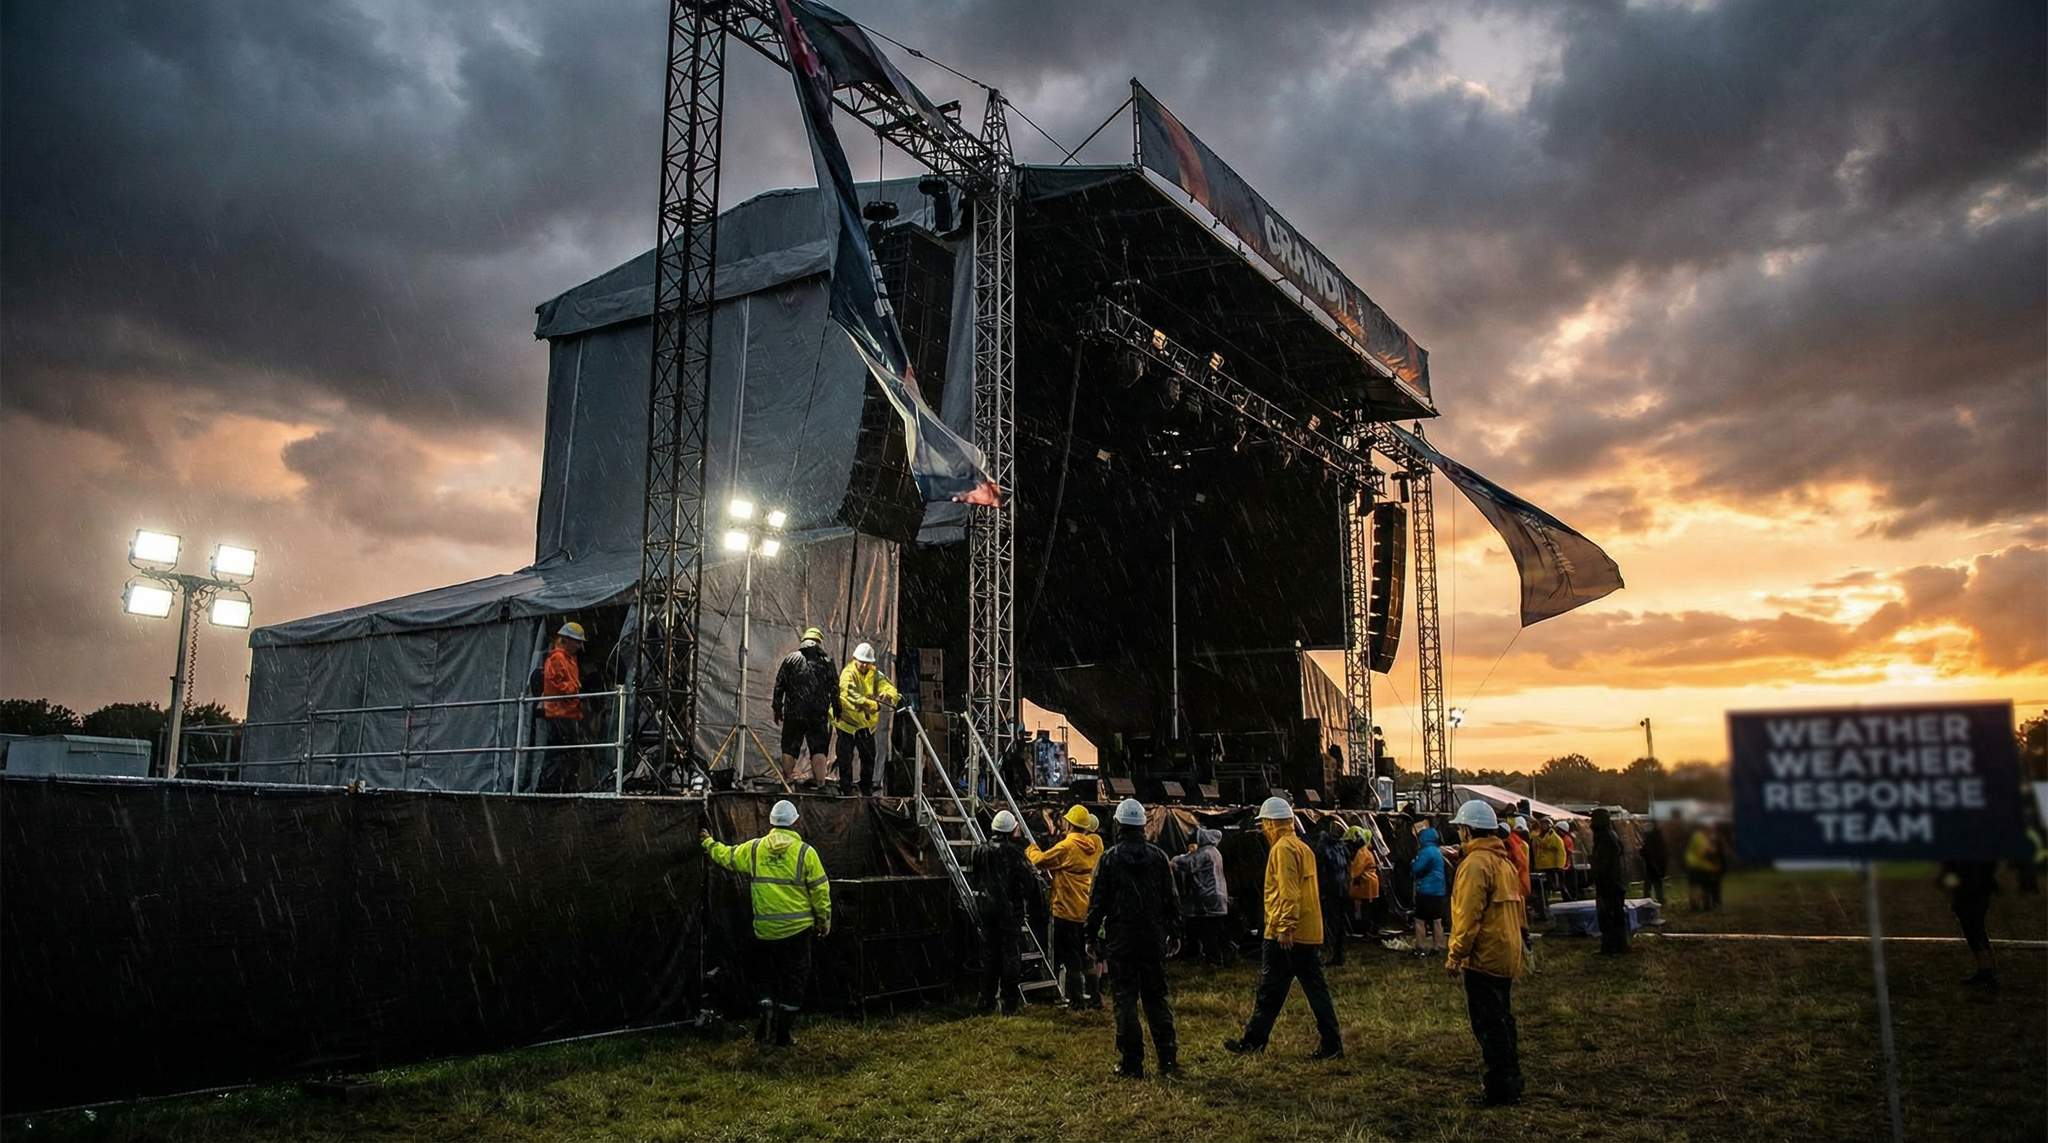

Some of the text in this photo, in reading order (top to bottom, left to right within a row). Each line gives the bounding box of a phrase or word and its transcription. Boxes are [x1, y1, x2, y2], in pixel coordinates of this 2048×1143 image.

[1767, 714, 1970, 747] WEATHER
[1769, 747, 1973, 778] WEATHER
[1764, 779, 1985, 810] RESPONSE
[1817, 812, 1933, 842] TEAM
